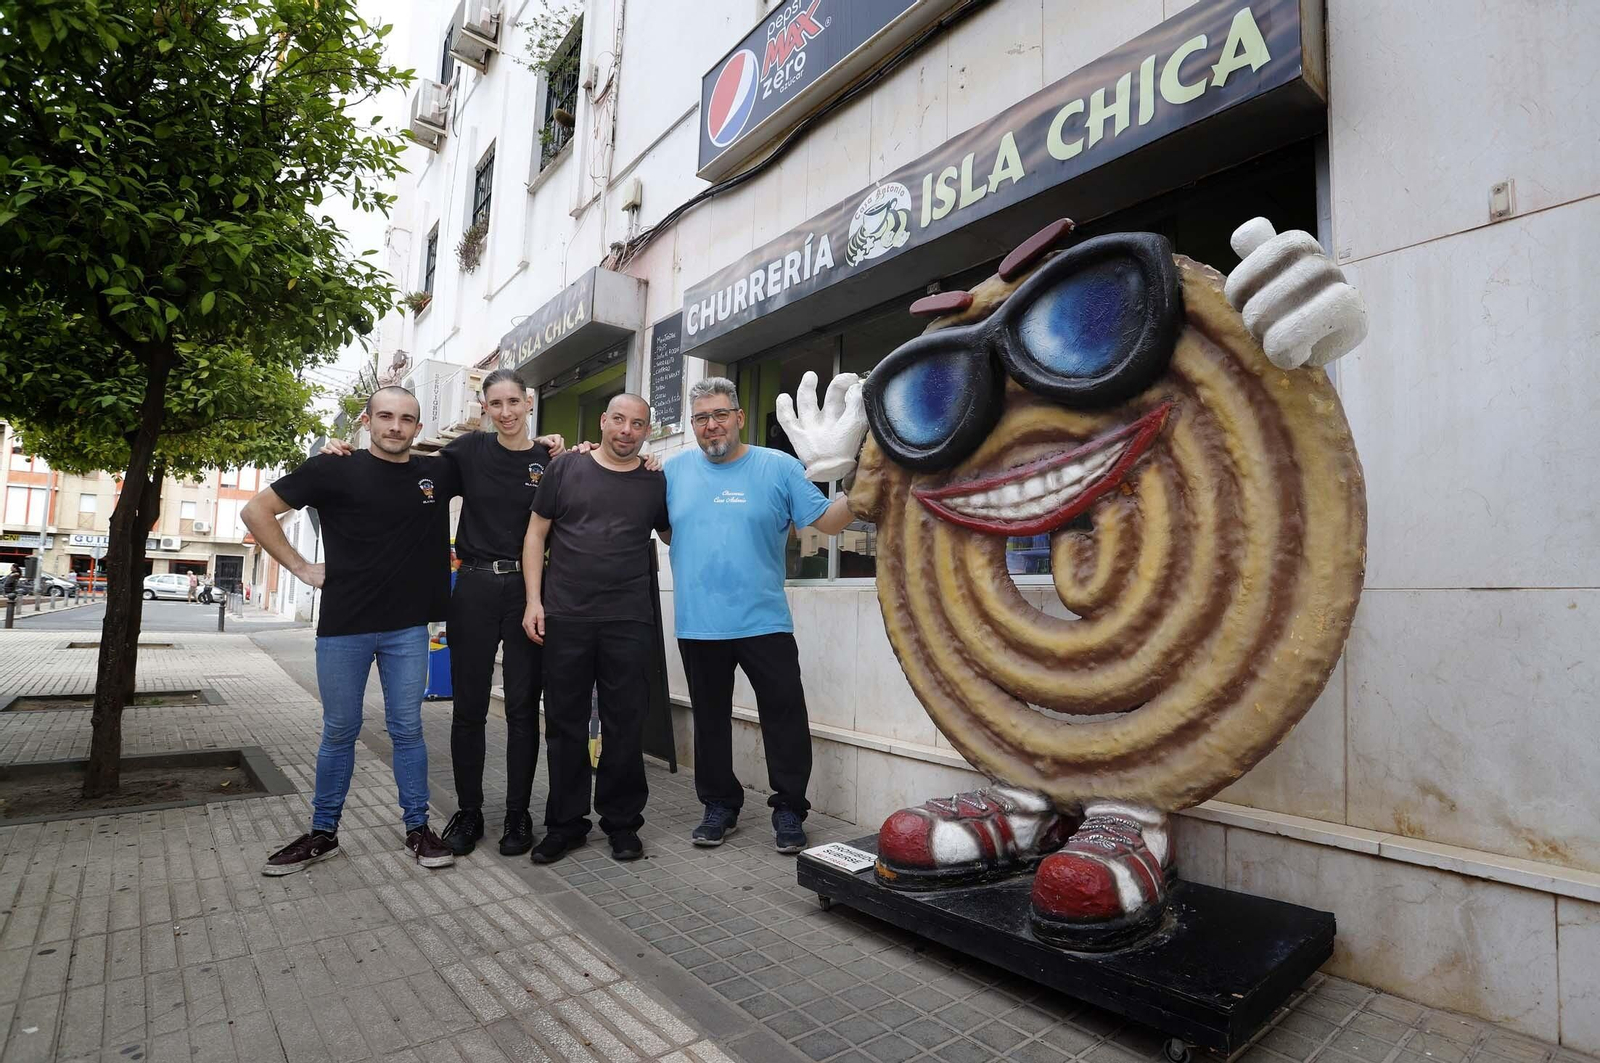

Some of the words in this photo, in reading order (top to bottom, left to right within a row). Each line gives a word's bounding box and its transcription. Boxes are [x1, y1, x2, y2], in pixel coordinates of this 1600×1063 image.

[761, 0, 824, 80] MAX
[767, 0, 802, 41] pepsi
[762, 51, 807, 100] zero
[779, 70, 804, 93] azúcar
[920, 131, 1026, 228] ISLA
[1046, 7, 1271, 161] CHICA
[686, 232, 835, 336] CHURRERÍA
[518, 332, 542, 363] ISLA
[545, 301, 585, 344] CHICA
